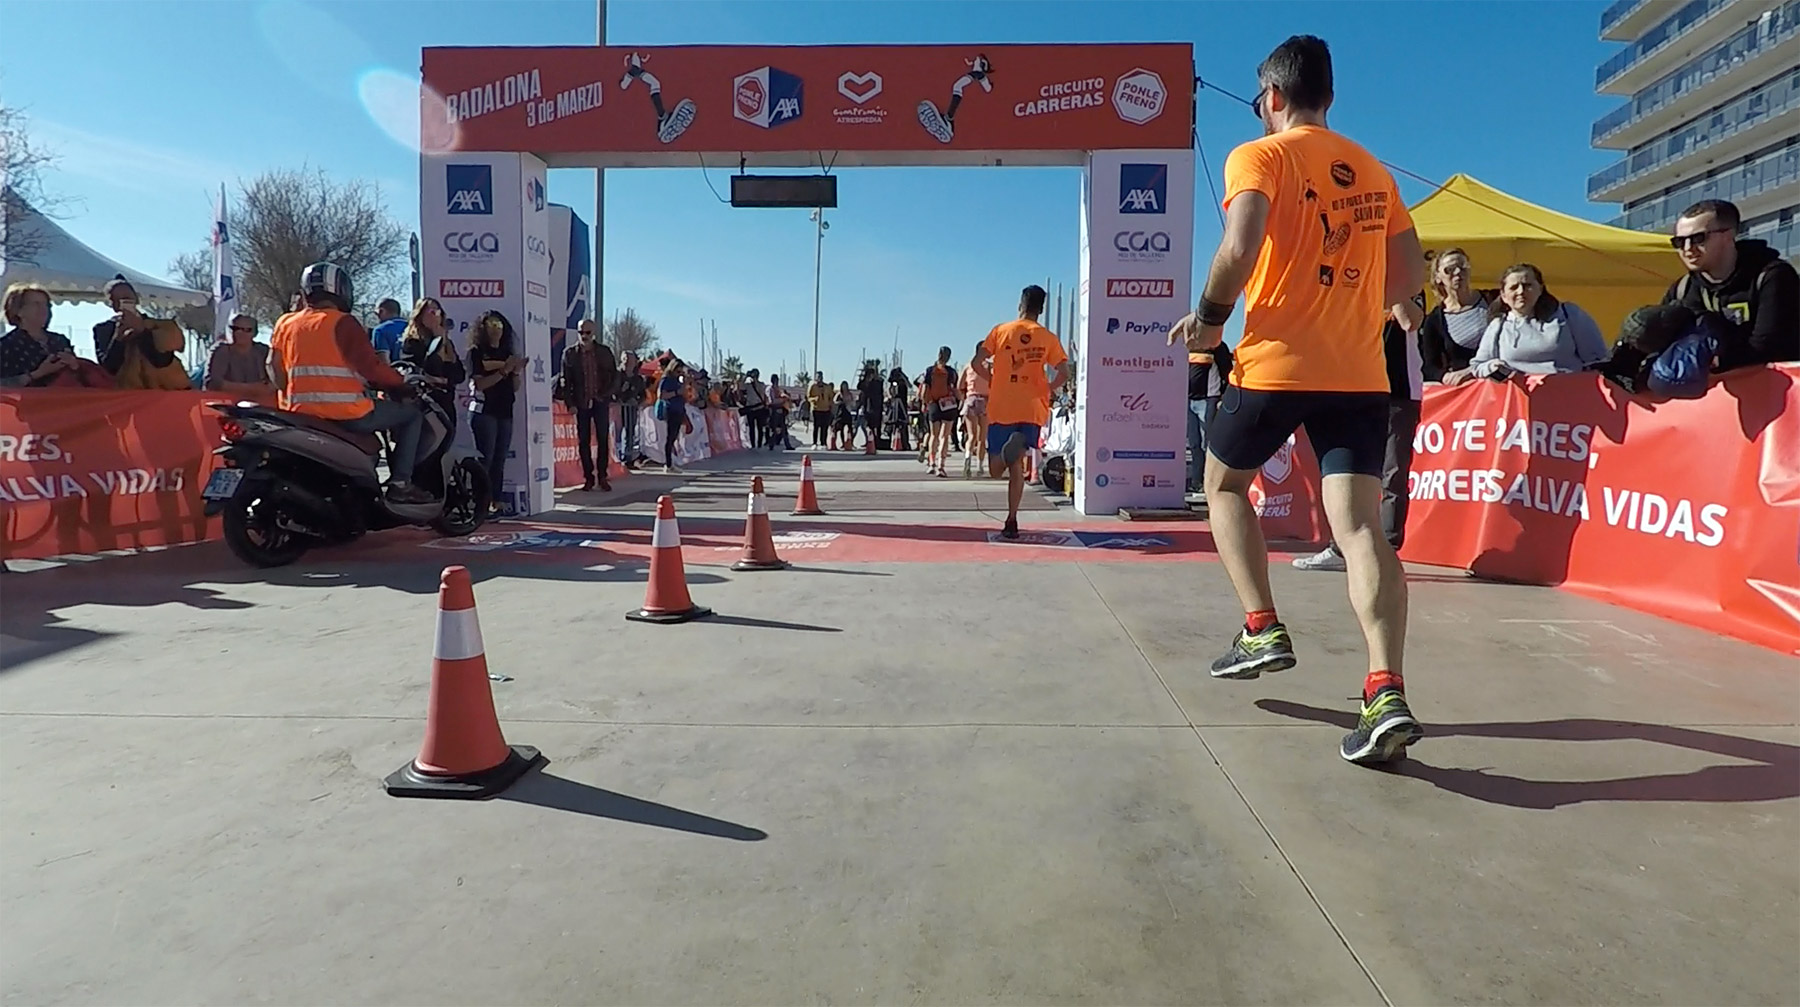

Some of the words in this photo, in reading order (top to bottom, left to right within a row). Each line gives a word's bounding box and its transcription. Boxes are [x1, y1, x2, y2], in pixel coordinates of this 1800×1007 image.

[446, 69, 541, 125] BADALONA
[1040, 77, 1104, 98] CIRCUITO
[1122, 82, 1160, 100] PONLE
[526, 107, 536, 128] 3
[538, 102, 555, 122] de
[555, 82, 603, 119] MARZO
[768, 98, 800, 123] AXA
[1014, 91, 1104, 117] CARRERAS
[1119, 91, 1157, 111] FRENO
[447, 190, 486, 211] AXA
[1119, 189, 1159, 210] AXA
[442, 281, 502, 296] MOTUL
[1109, 280, 1172, 296] MOTUL
[1125, 321, 1173, 335] PayPal
[1102, 356, 1174, 369] Montigalà
[1452, 419, 1486, 452] TE
[89, 467, 185, 496] VIDAS
[1482, 469, 1590, 520] SALVA
[1603, 486, 1728, 548] VIDAS
